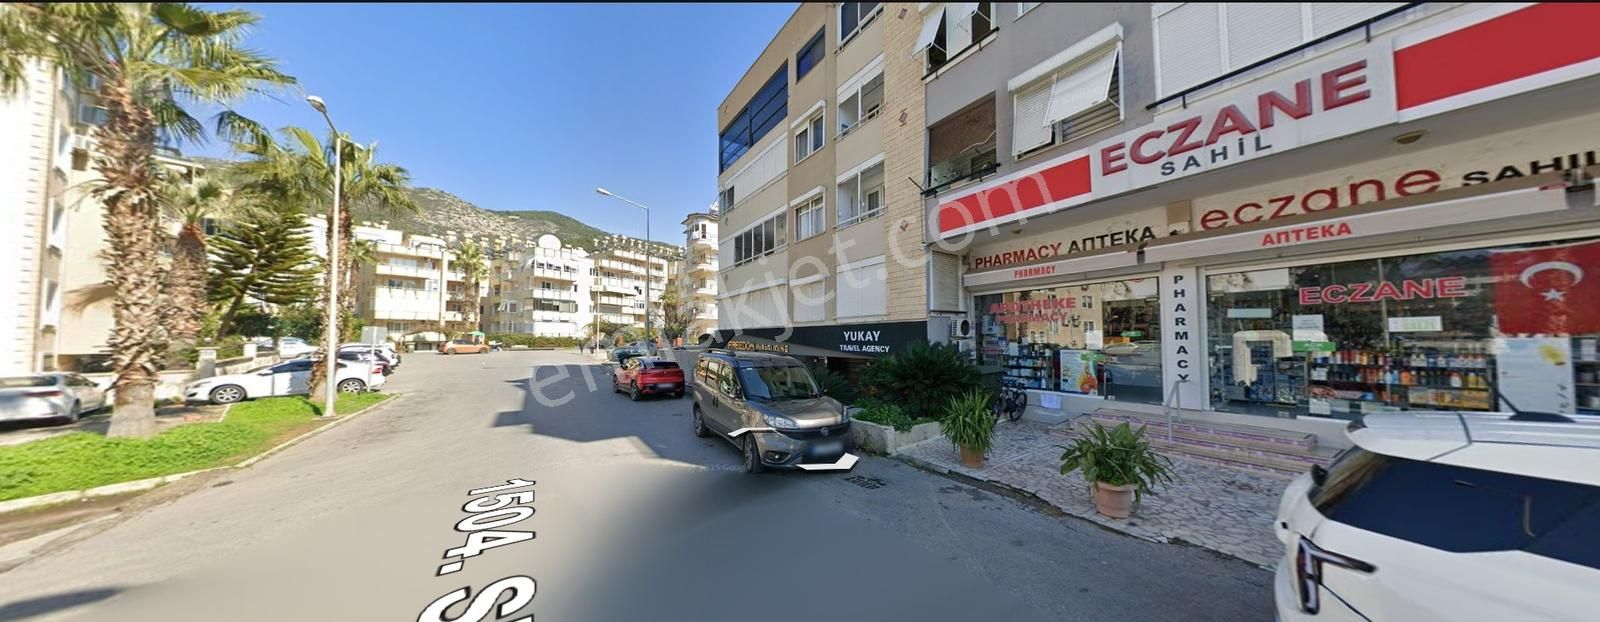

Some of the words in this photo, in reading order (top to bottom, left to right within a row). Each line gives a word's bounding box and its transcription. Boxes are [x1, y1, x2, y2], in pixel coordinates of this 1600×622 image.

[1101, 59, 1371, 177] ECZANE
[1161, 134, 1273, 176] SAHİL
[1200, 169, 1442, 231] eczane
[975, 242, 1063, 269] PHARMACY
[1067, 226, 1156, 254] АПТЕКА
[1261, 222, 1352, 247] АПТЕКА
[1014, 264, 1056, 279] PHARMACY
[1299, 276, 1467, 305] ECZANE
[989, 297, 1077, 314] APOTHEKE
[843, 330, 881, 342] YUKAY
[1173, 275, 1189, 382] PHARMACY
[727, 340, 755, 352] FREEDOM
[839, 344, 861, 352] TRAVEL
[862, 345, 890, 353] AGENCY
